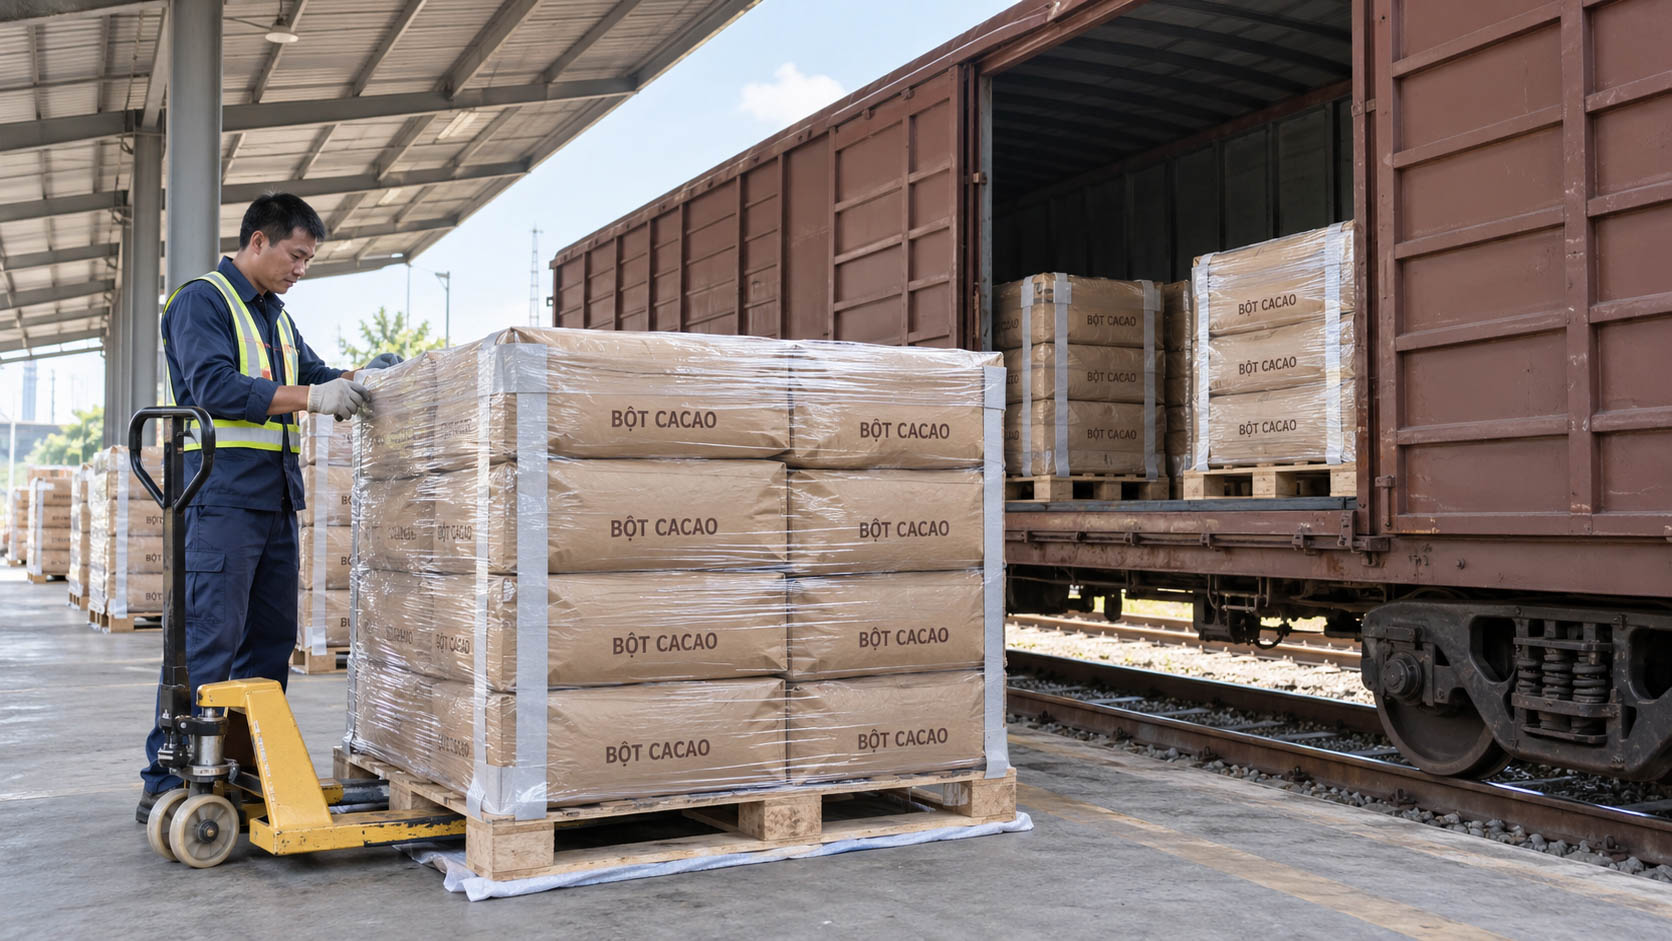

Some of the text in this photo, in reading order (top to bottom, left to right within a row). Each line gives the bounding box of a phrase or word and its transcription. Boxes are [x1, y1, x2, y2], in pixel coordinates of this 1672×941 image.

[1238, 293, 1297, 317] BỘT CACAO
[1087, 313, 1137, 327] BỘT CACAO
[1087, 370, 1137, 383] BỘT CACAO
[1238, 356, 1297, 376] BỘT CACAO
[611, 406, 717, 432] BỘT CACAO
[860, 418, 950, 443] BỘT CACAO
[1238, 419, 1297, 438] BỘT CACAO
[1087, 427, 1137, 441] BỘT CACAO
[610, 515, 718, 542] BỘT CACAO
[859, 518, 950, 543] BỘT CACAO
[612, 631, 718, 659] BỘT CACAO
[859, 627, 949, 651] BỘT CACAO
[858, 727, 949, 753] BỘT CACAO
[605, 738, 711, 767] BỘT CACAO
